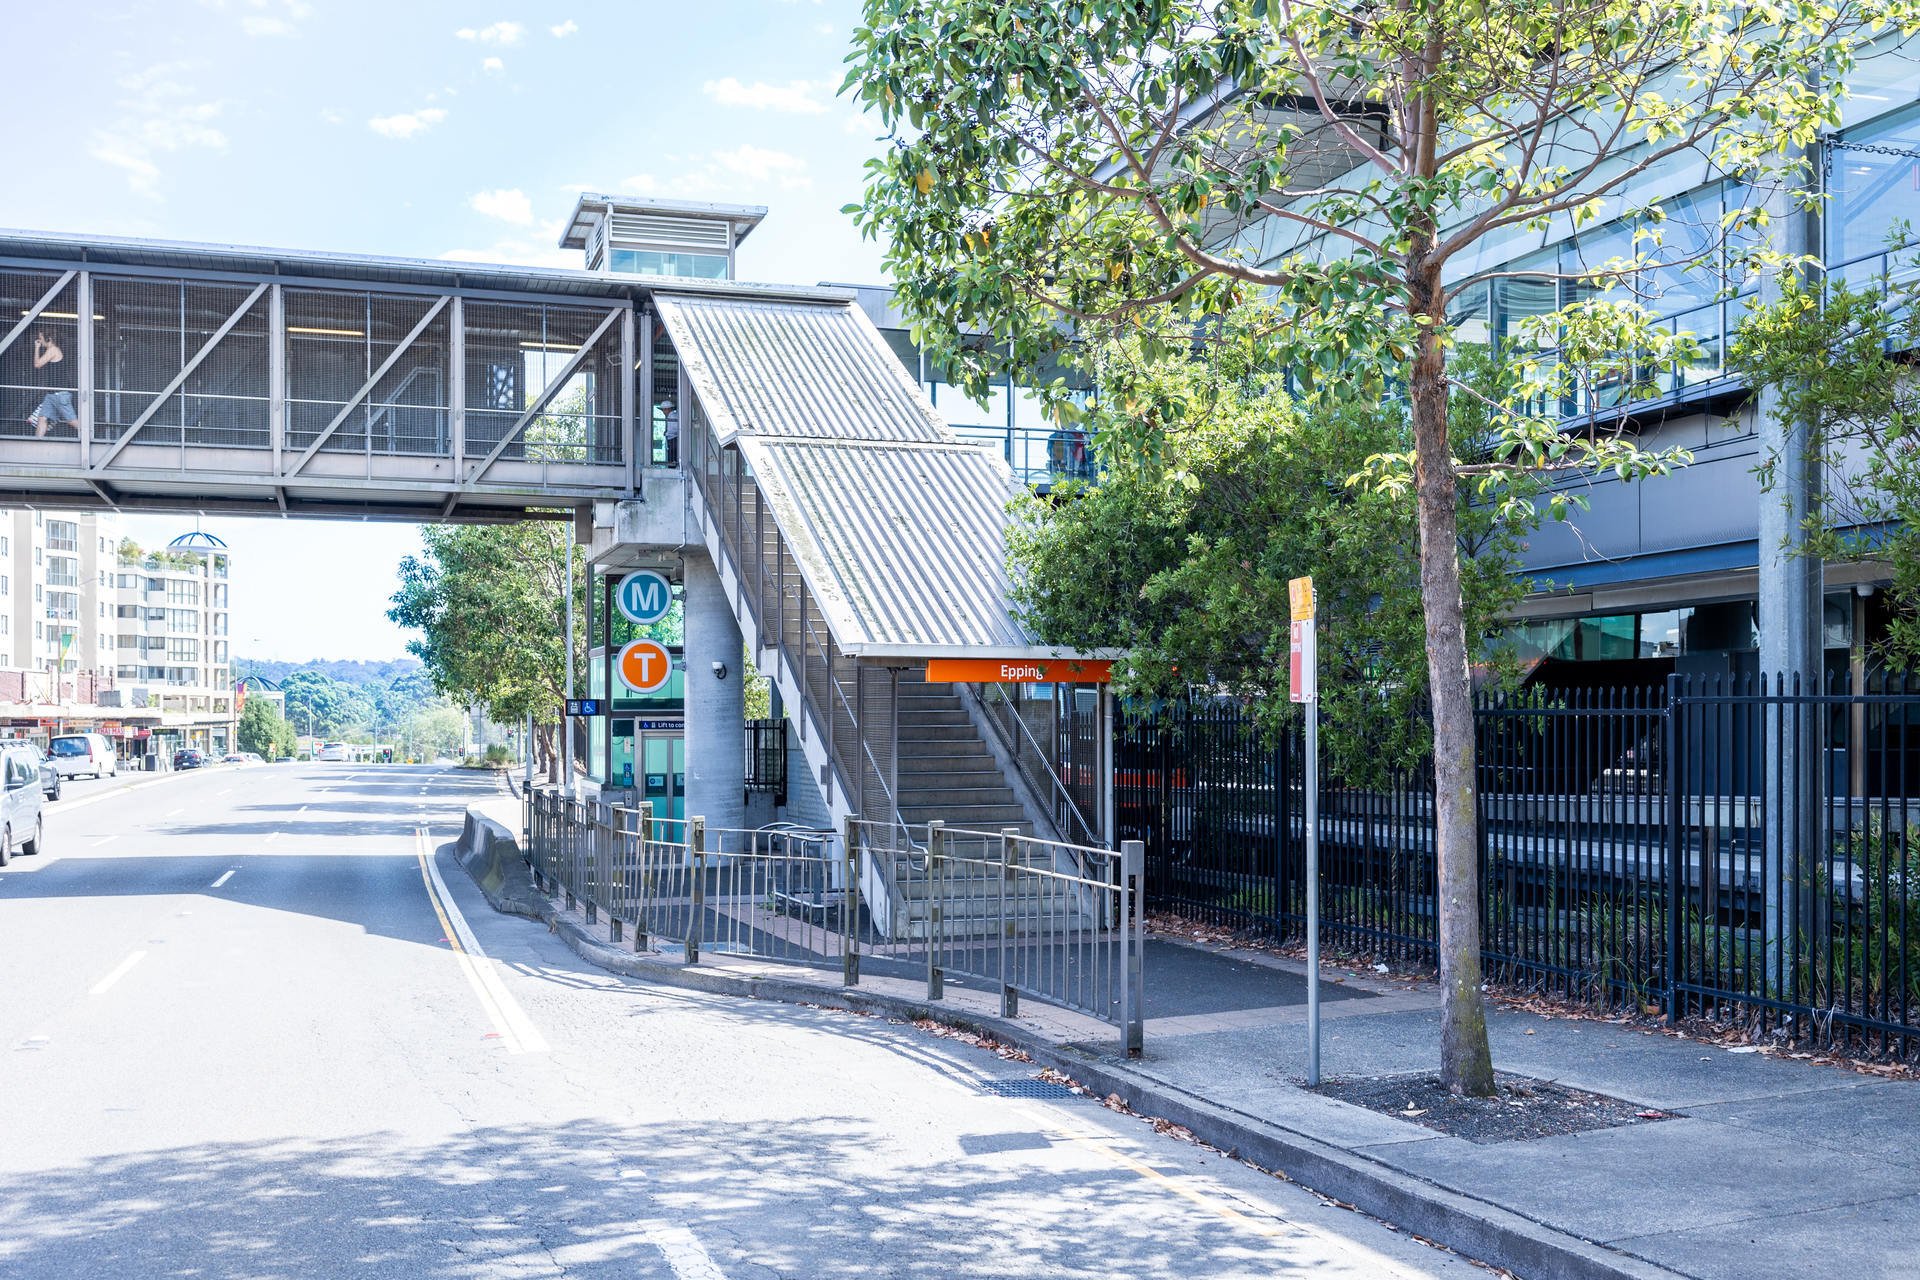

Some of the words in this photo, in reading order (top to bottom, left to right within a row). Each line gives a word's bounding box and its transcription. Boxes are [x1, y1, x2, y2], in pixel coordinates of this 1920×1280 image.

[631, 583, 659, 611] M
[634, 653, 656, 682] T
[1001, 664, 1044, 680] Epping
